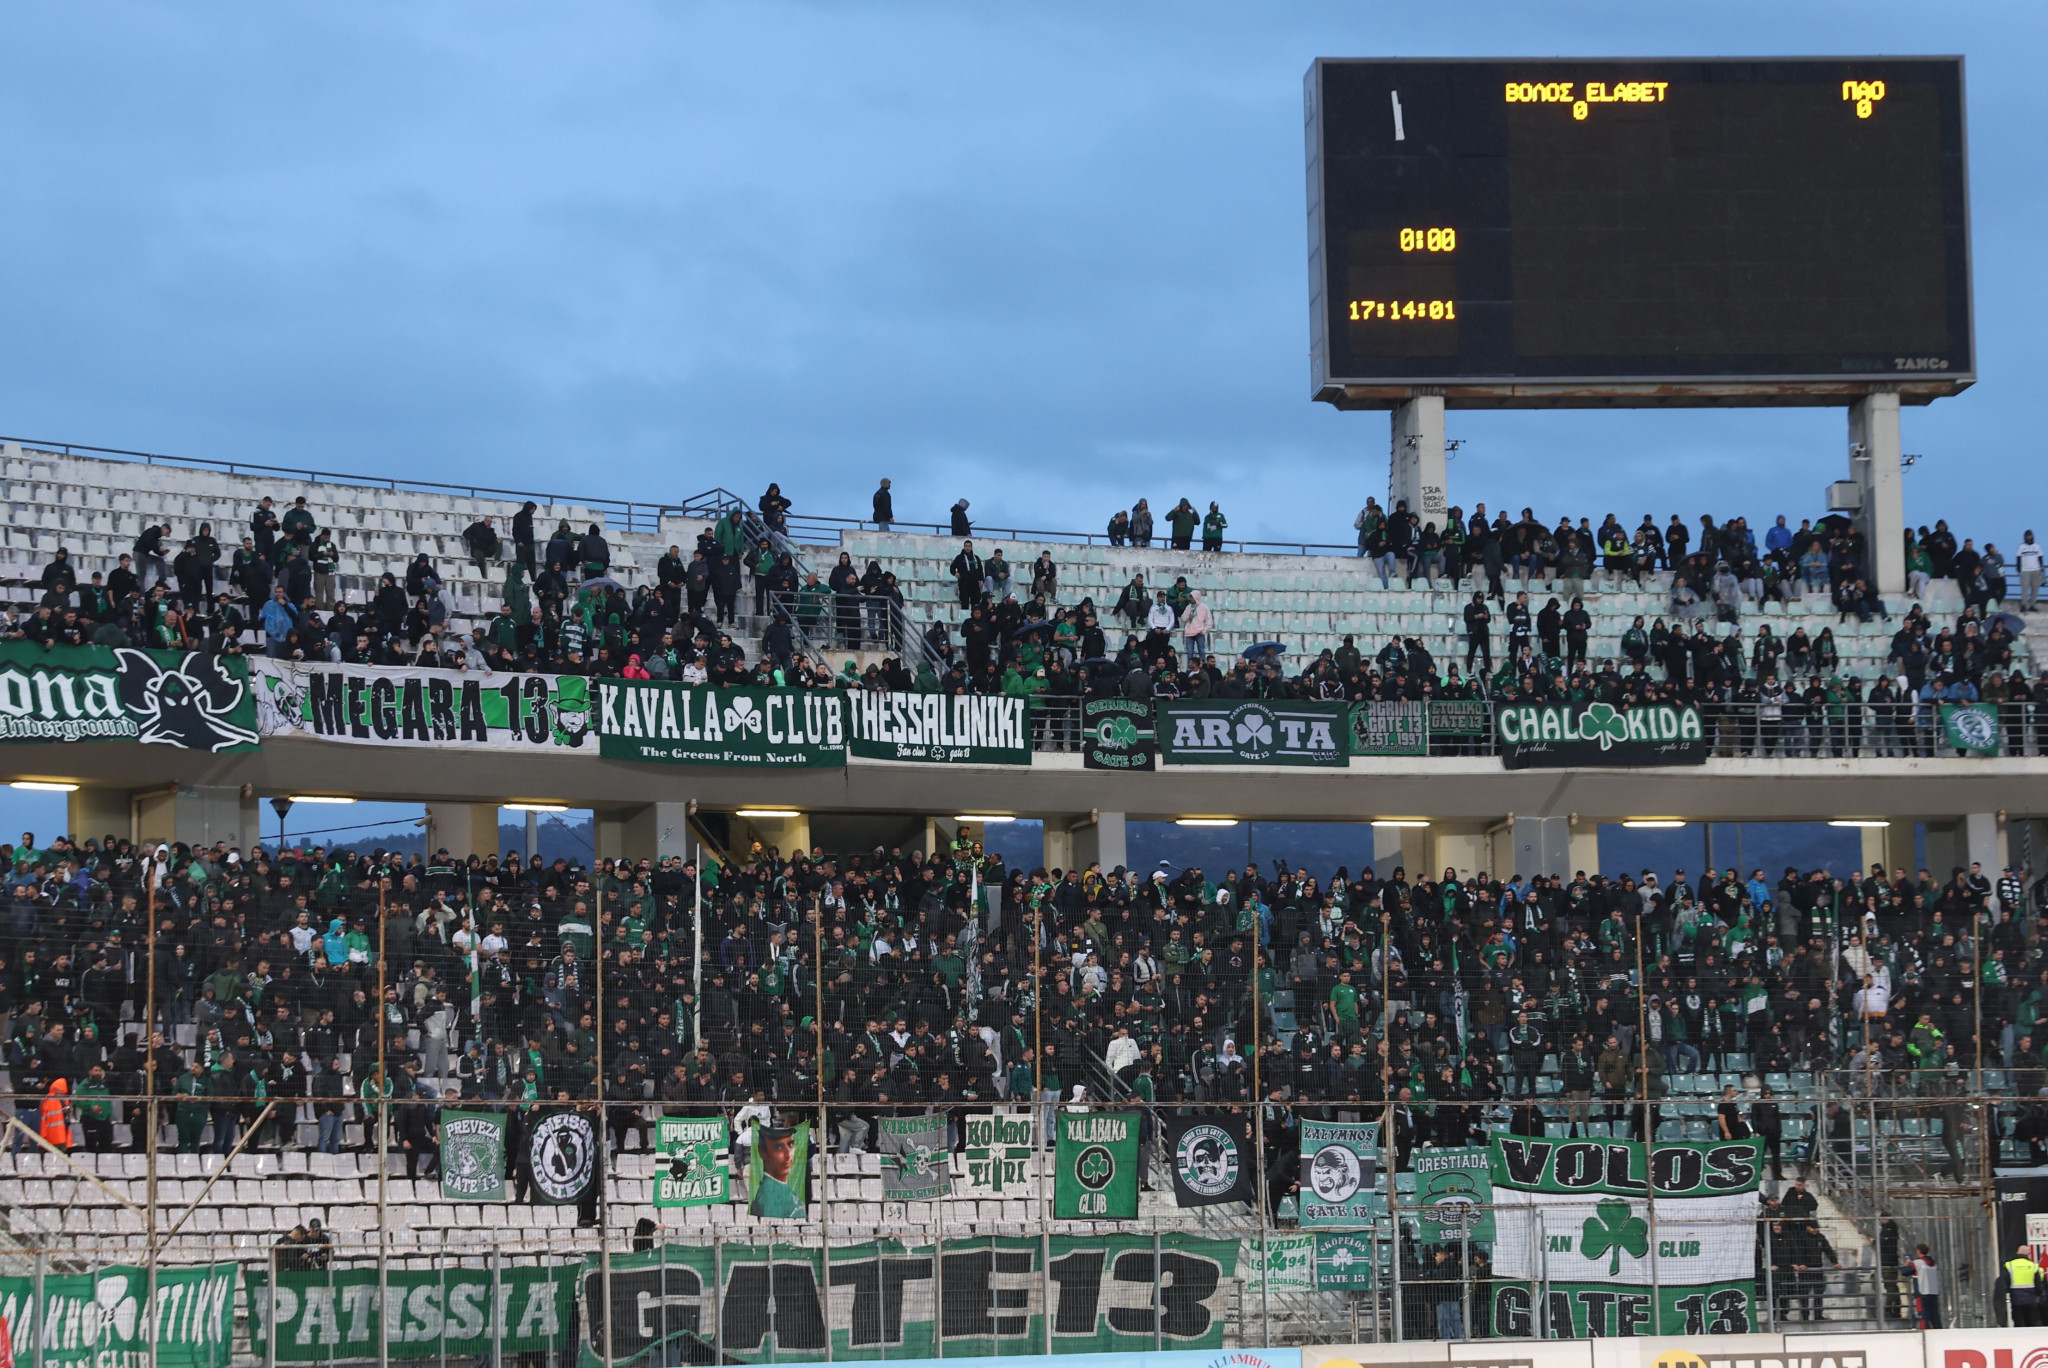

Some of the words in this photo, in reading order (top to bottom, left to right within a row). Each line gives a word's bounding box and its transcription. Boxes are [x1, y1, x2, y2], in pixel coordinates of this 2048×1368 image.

[1586, 82, 1668, 102] ELABET
[1842, 80, 1885, 101] ΠΑΟ
[1573, 100, 1588, 120] 0
[1856, 100, 1872, 119] 0
[1400, 228, 1455, 252] 0:00
[1349, 300, 1456, 320] 17:14:01
[309, 671, 488, 742] MEGARA
[500, 676, 549, 744] 13
[600, 683, 724, 742] KAVALA
[766, 694, 844, 745] CLUB
[1086, 699, 1148, 717] SERRES
[1431, 702, 1481, 715] ETOLIKO
[846, 688, 1025, 749] THESSALONIKI
[1368, 716, 1405, 733] GATE
[1408, 716, 1422, 733] 13
[1431, 714, 1464, 729] GATE
[1469, 714, 1481, 729] 13
[1369, 732, 1394, 746] EST.
[1396, 732, 1423, 746] 1997
[640, 746, 668, 759] The
[671, 748, 720, 761] Greens
[723, 750, 761, 763] From
[766, 752, 807, 763] North
[1092, 750, 1130, 767] GATE
[1131, 752, 1147, 766] 13
[1239, 750, 1260, 760] GATE
[1261, 751, 1270, 759] 13
[445, 1119, 500, 1143] PREVEZA
[1067, 1118, 1127, 1143] KALABAKA
[1195, 1127, 1209, 1136] CLUB
[1304, 1126, 1375, 1142] KALYMNOS
[1417, 1153, 1489, 1174] ORESTIADA
[1498, 1137, 1757, 1192] VOLOS
[660, 1179, 702, 1200] ΘΥΡΑ
[704, 1174, 722, 1197] 13
[1078, 1193, 1107, 1215] CLUB
[1305, 1203, 1348, 1220] GATE
[1351, 1205, 1368, 1219] 13
[1320, 1236, 1367, 1253] SKOPELOS
[1547, 1235, 1572, 1252] AN
[1658, 1240, 1701, 1258] CLUB
[1321, 1274, 1348, 1284] GATE
[1353, 1273, 1365, 1283] 13
[243, 1281, 561, 1345] PATISSIA
[1494, 1286, 1650, 1339] GATE
[1675, 1288, 1749, 1336] 13
